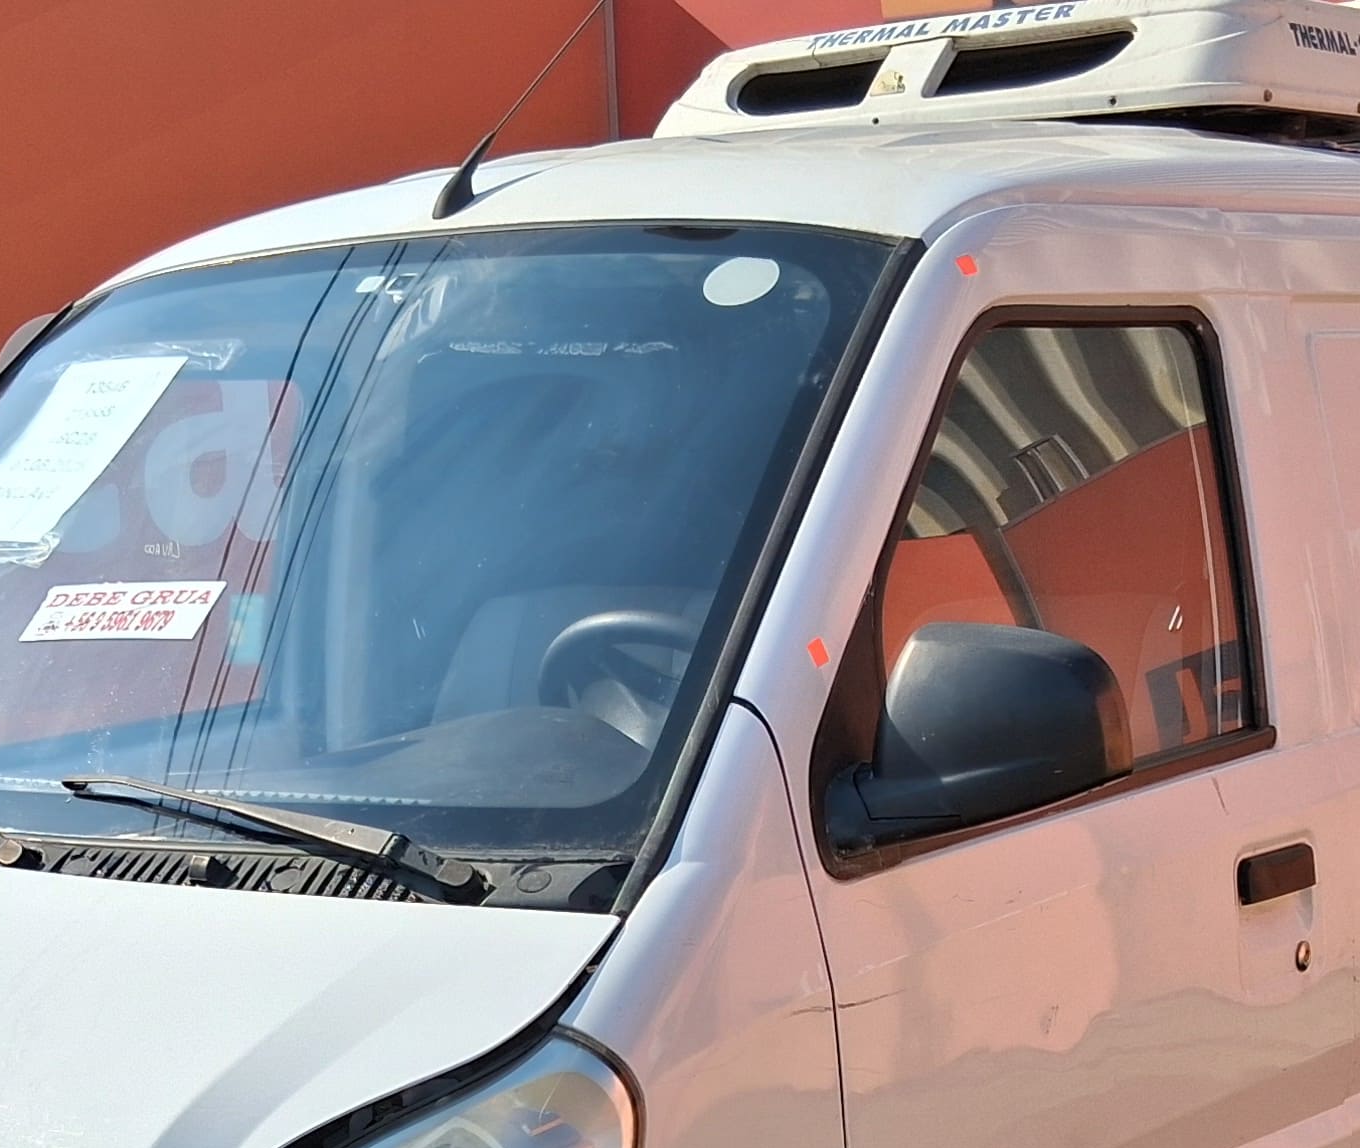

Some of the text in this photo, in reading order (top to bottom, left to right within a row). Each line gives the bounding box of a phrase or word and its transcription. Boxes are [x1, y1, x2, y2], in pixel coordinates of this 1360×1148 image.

[807, 4, 1076, 49] THERMAL MASTER
[46, 589, 212, 608] DEBE GRUA
